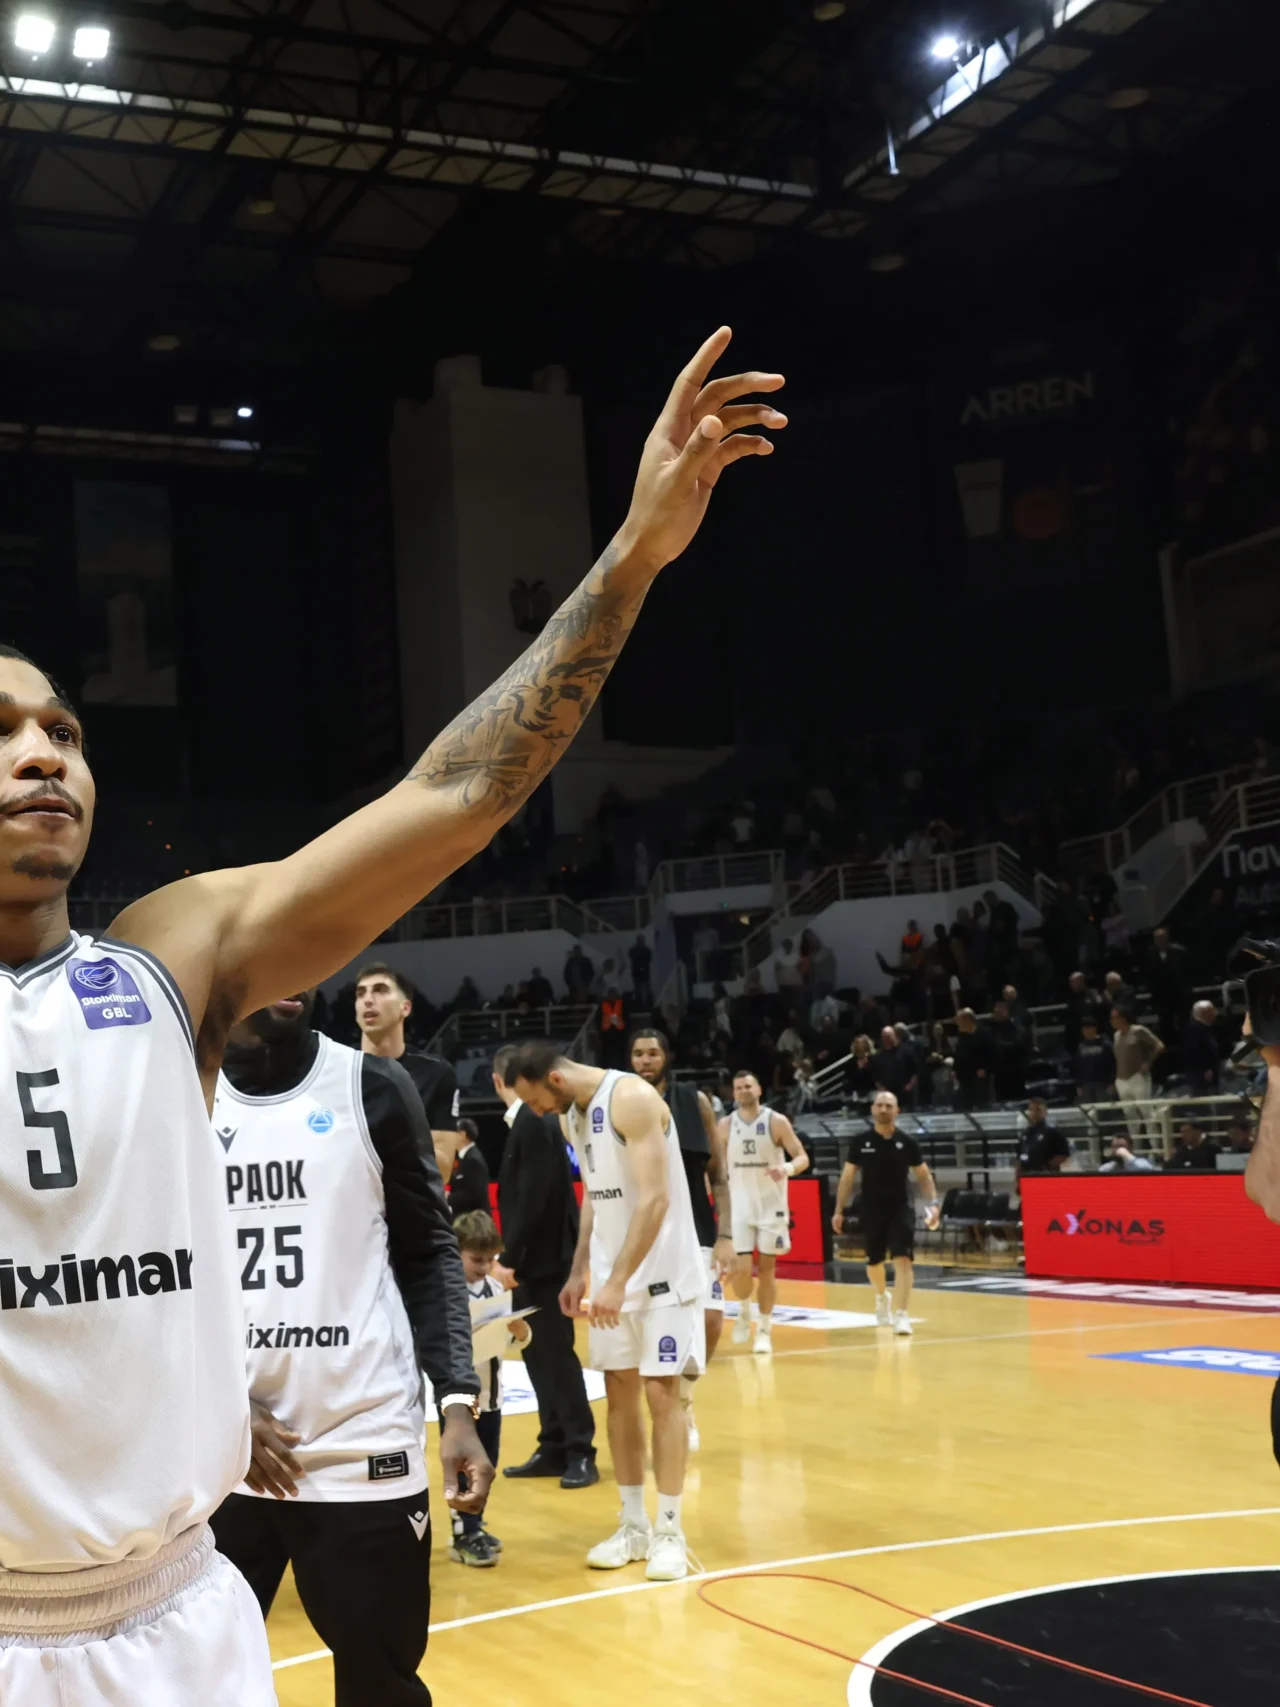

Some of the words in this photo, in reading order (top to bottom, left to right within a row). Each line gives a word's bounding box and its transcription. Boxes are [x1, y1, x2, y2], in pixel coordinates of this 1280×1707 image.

[81, 994, 141, 1006] Stoiximan
[102, 1007, 132, 1020] GBL
[16, 1068, 78, 1190] 5
[226, 1159, 307, 1205] PAOK
[237, 1225, 304, 1291] 25
[246, 1322, 350, 1349] iximan
